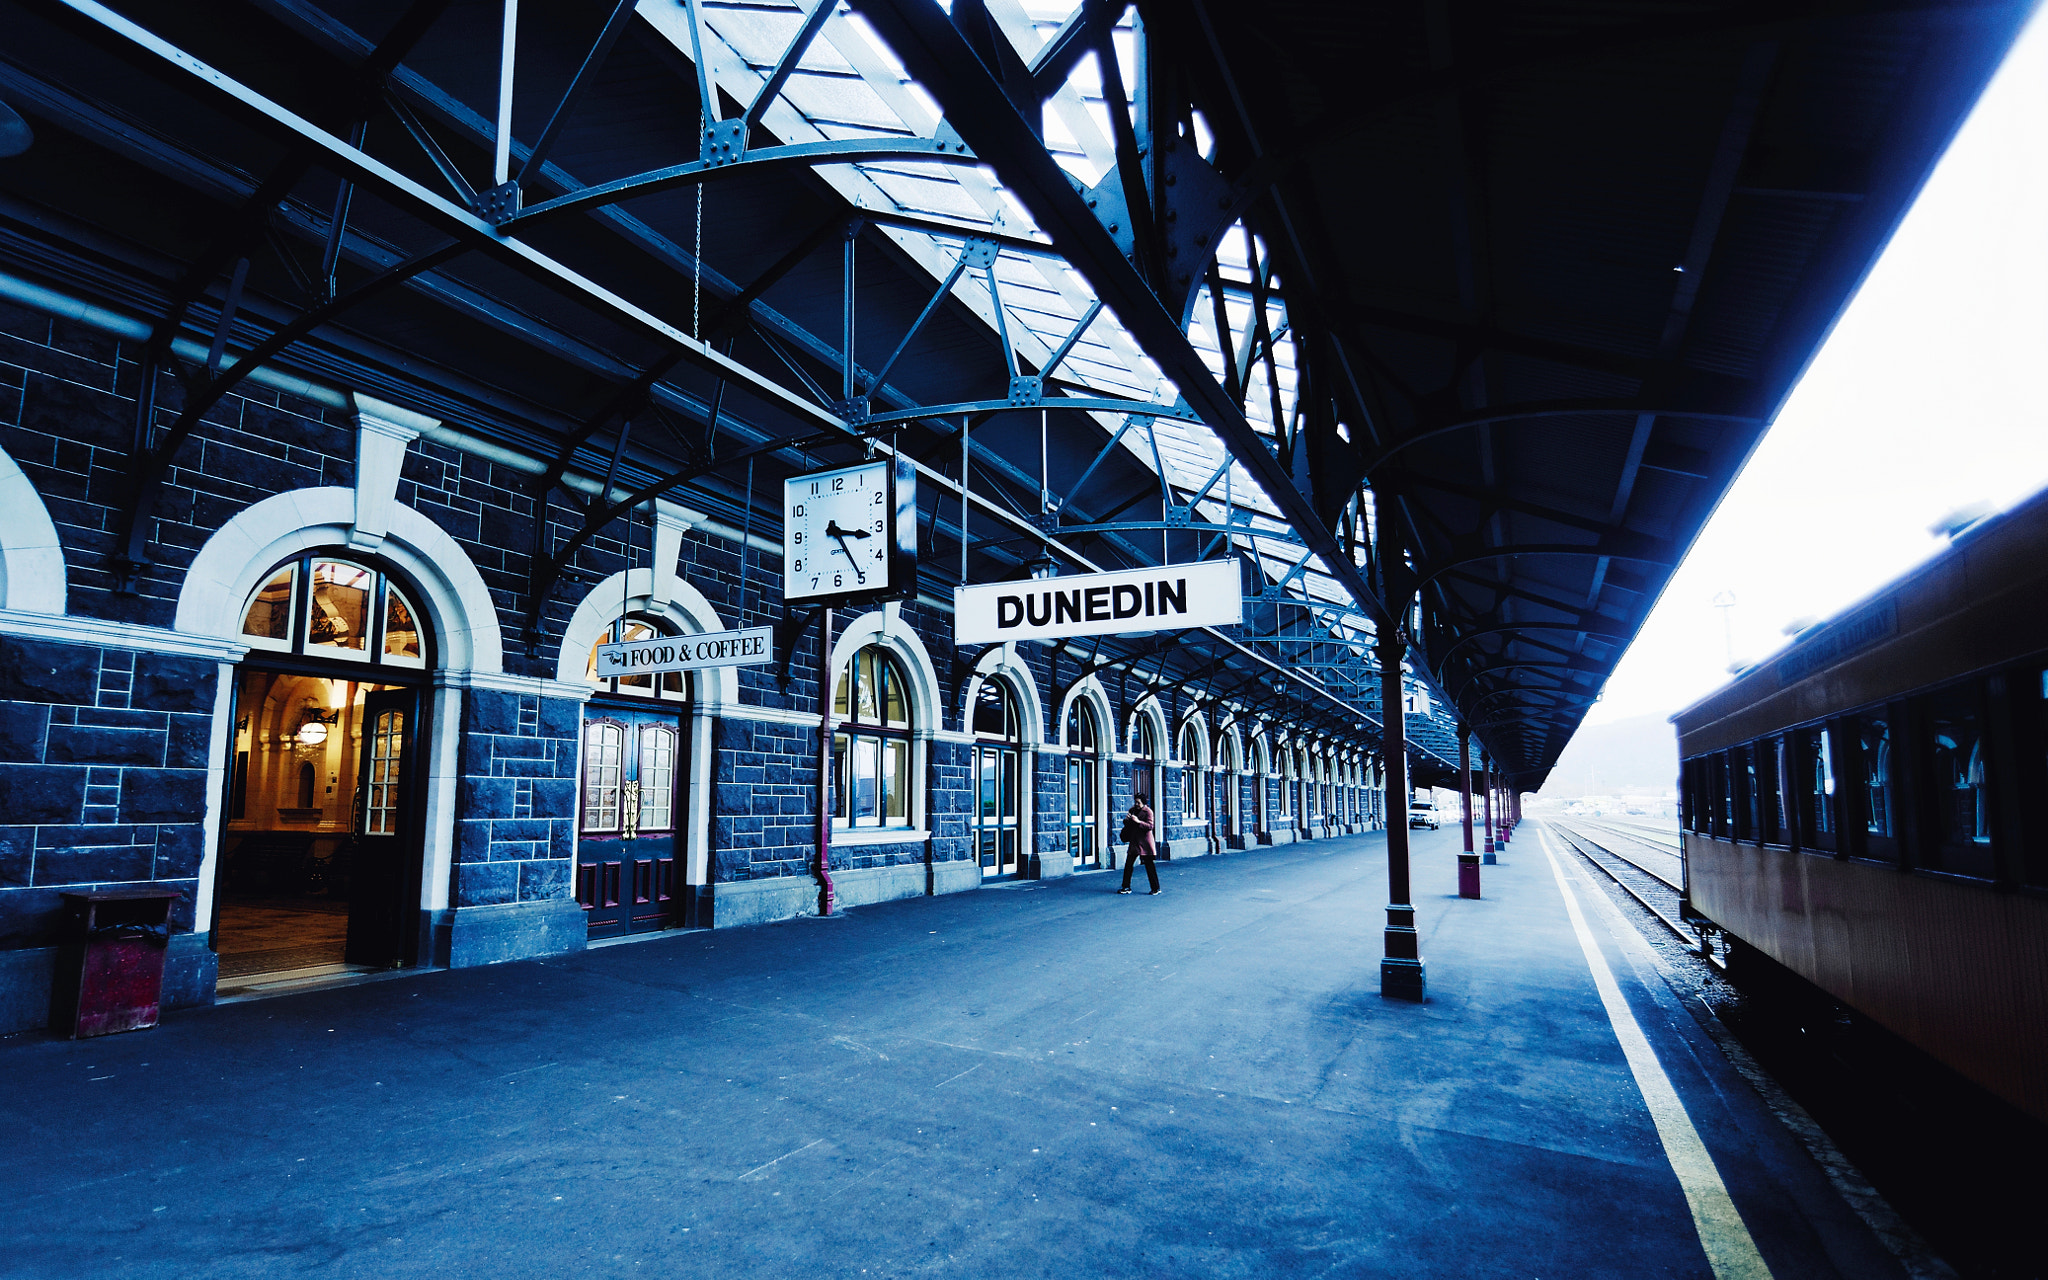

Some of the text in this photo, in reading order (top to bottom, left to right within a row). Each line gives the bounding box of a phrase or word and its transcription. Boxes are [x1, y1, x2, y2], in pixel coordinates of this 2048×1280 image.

[811, 482, 819, 495] 11
[832, 478, 843, 491] 12
[875, 492, 883, 504] 2
[793, 505, 804, 518] 10
[875, 520, 883, 532] 3
[794, 532, 802, 544] 9
[875, 549, 883, 561] 4
[794, 560, 802, 572] 8
[811, 577, 819, 590] 7
[834, 575, 842, 587] 6
[857, 571, 866, 584] 5
[997, 578, 1187, 629] DUNEDIN
[631, 636, 765, 667] FOOD & COFFEE
[1405, 696, 1414, 712] 1
